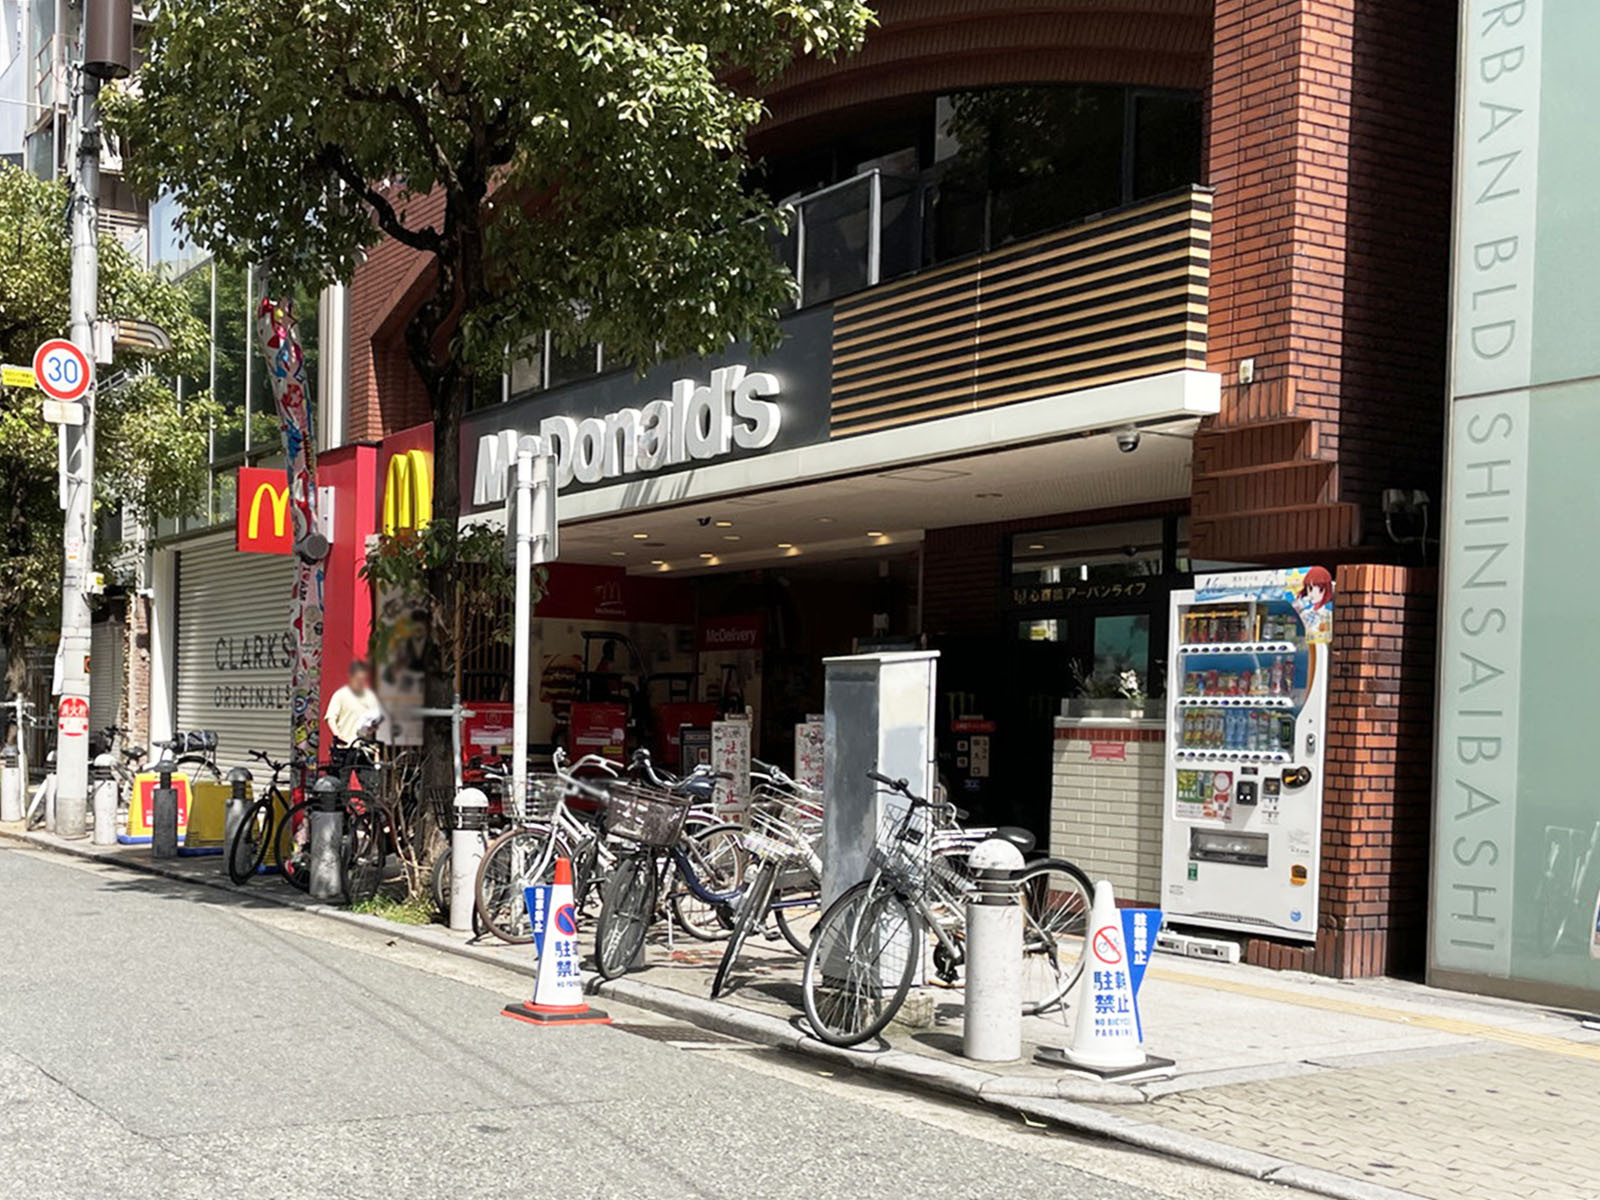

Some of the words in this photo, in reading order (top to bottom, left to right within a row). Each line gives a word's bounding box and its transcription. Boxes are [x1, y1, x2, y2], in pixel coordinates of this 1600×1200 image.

[1470, 235, 1519, 361] BLD
[48, 356, 78, 384] 30
[706, 628, 757, 645] McDelivery
[1449, 412, 1513, 951] SHINSAIBASHI
[1094, 994, 1131, 1014] 禁止
